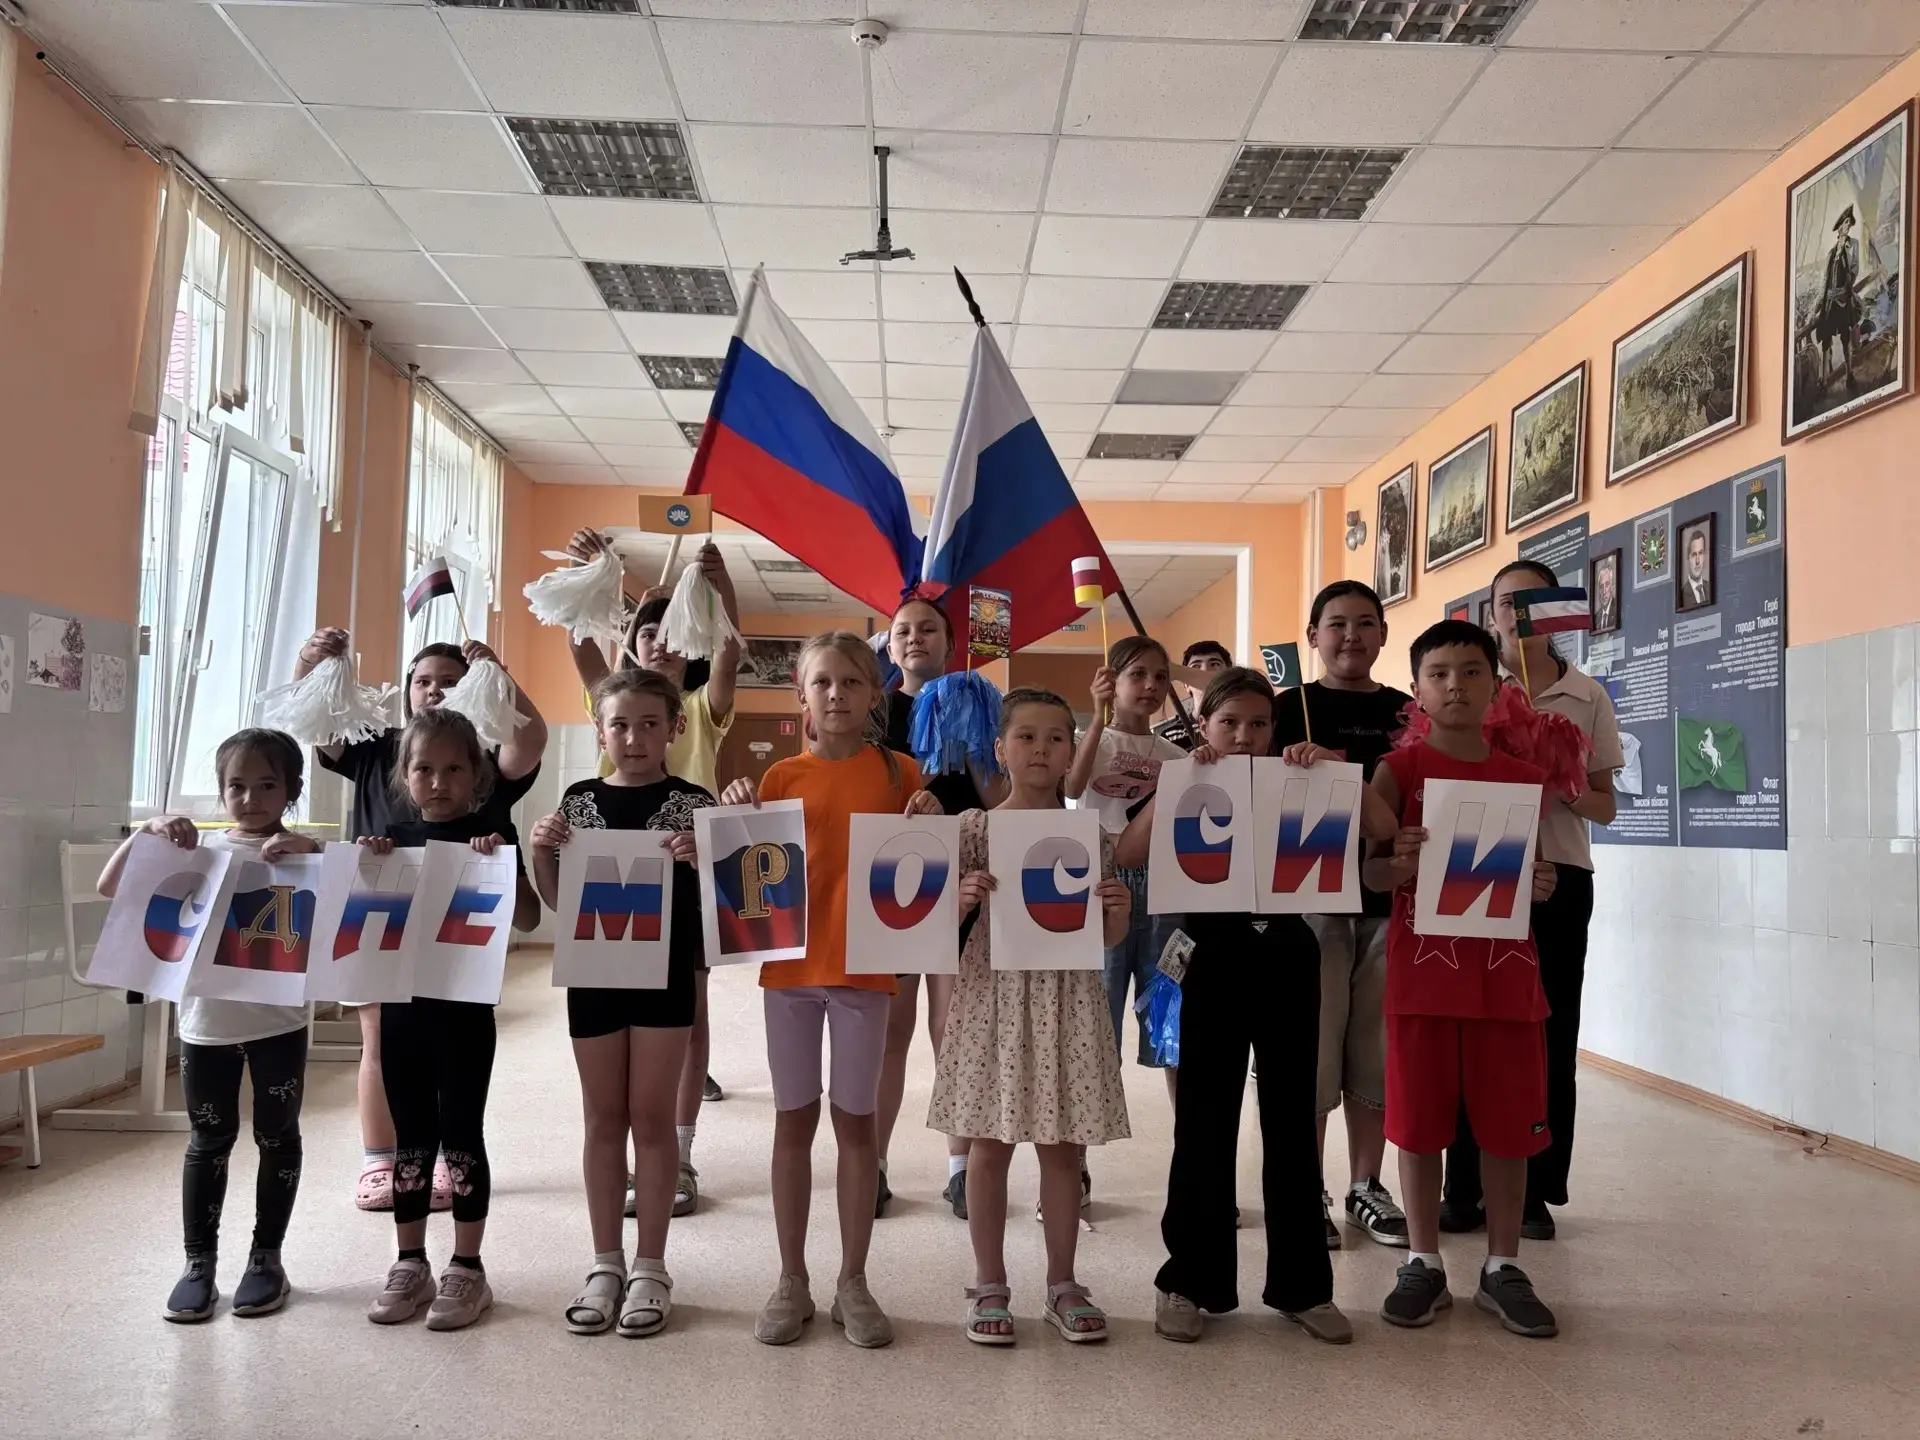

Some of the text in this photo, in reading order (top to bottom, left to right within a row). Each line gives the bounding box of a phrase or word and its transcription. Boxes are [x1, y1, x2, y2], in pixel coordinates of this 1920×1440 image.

[1764, 597, 1778, 614] Герб
[1735, 615, 1778, 635] города Томска
[1658, 627, 1668, 640] Герб
[1633, 643, 1650, 657] Томской
[1651, 640, 1668, 653] области
[1656, 783, 1668, 794] Флаг
[1763, 777, 1779, 789] Флаг
[1632, 796, 1668, 808] Томской области
[1737, 792, 1779, 807] города Томска
